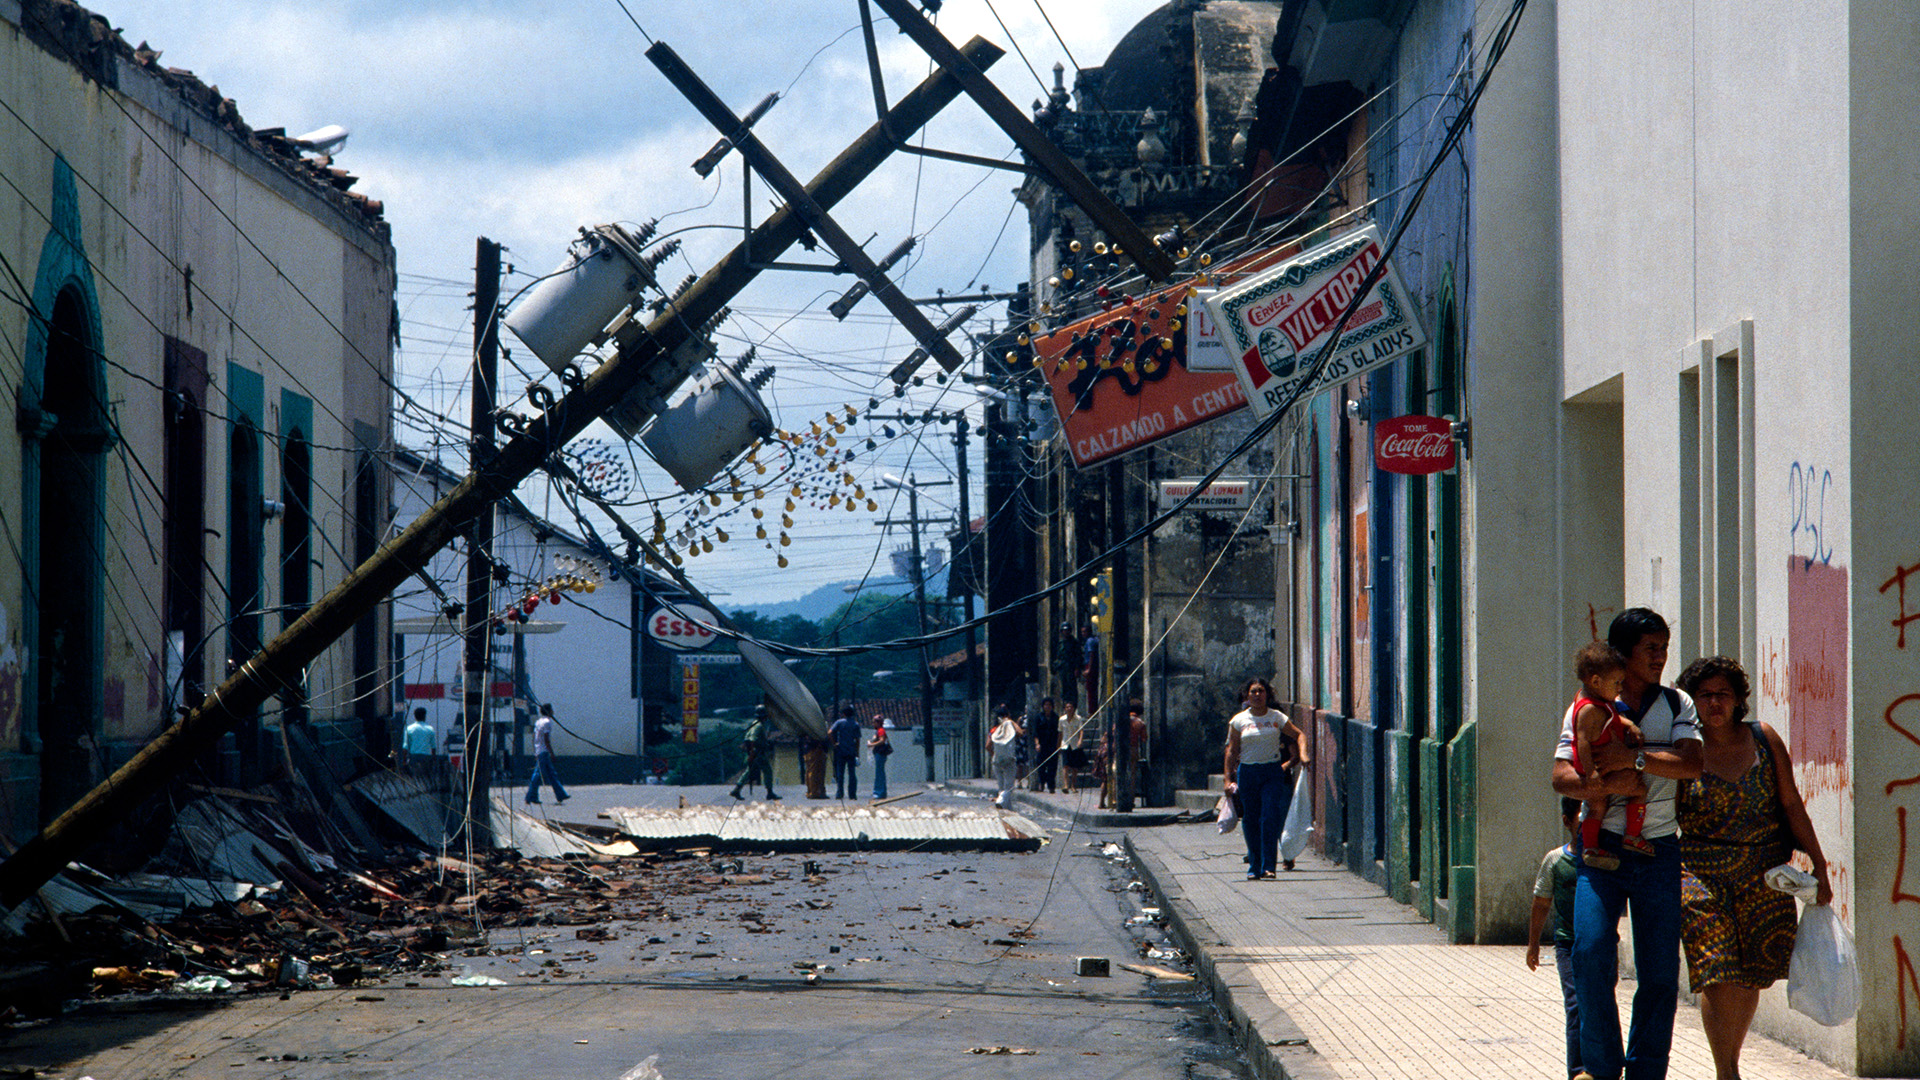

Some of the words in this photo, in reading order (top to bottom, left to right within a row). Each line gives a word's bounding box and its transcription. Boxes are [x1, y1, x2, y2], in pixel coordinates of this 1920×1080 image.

[1077, 411, 1165, 460] CALZANDO
[1173, 404, 1188, 426] A
[1403, 424, 1428, 433] TOME
[1380, 432, 1451, 459] Coca-Cola
[1165, 486, 1210, 496] GUILLEO
[1173, 497, 1237, 505] IMORTACIONES
